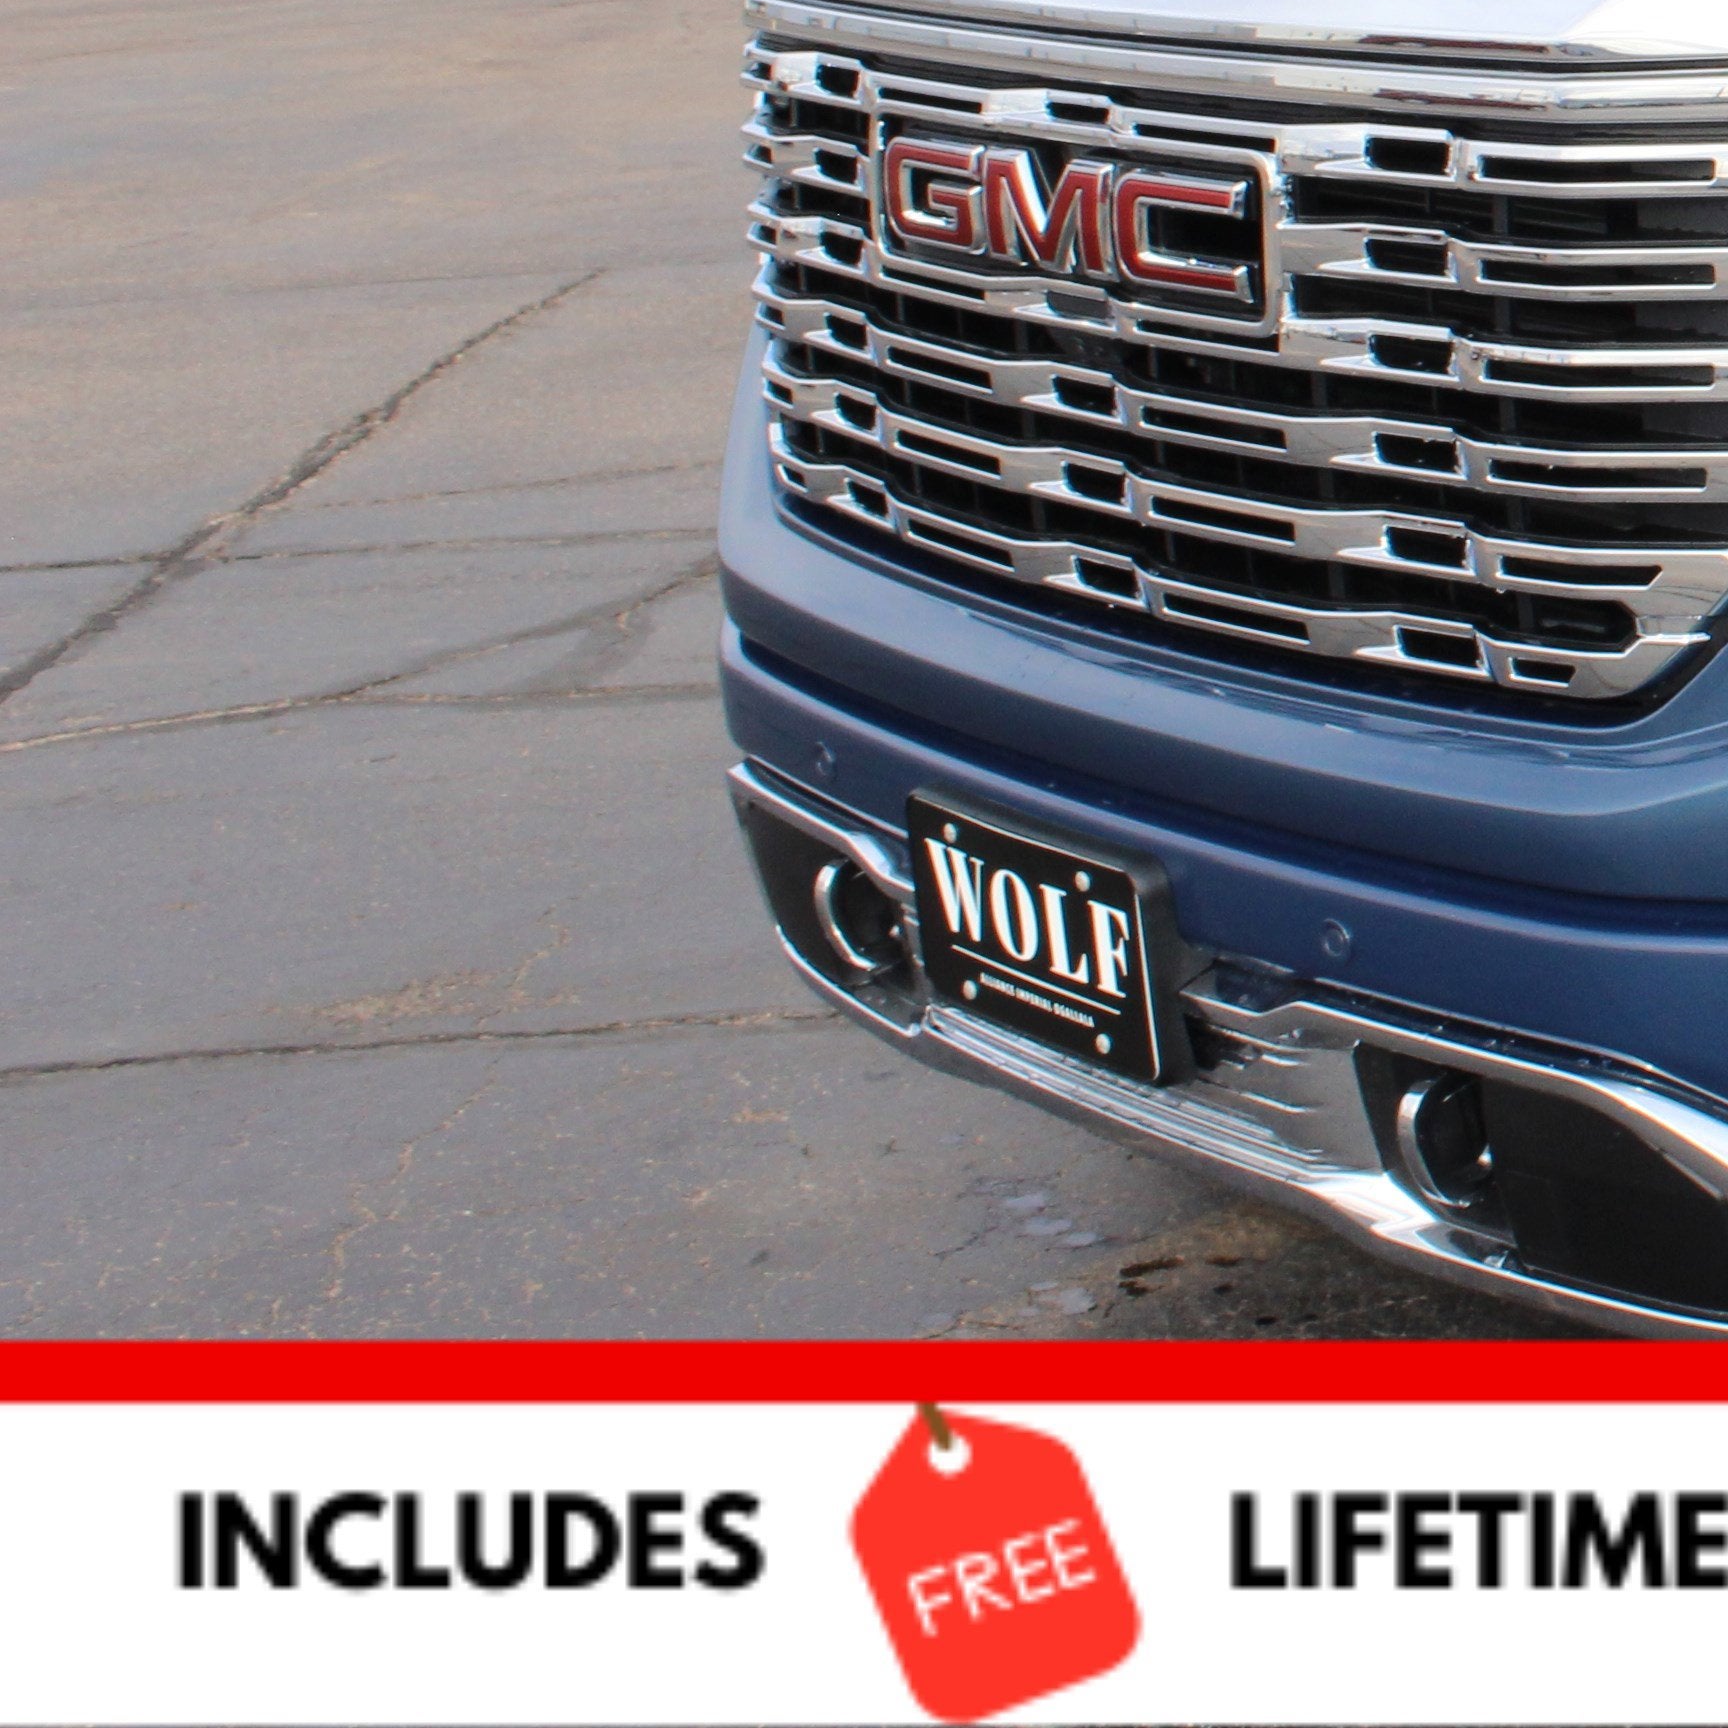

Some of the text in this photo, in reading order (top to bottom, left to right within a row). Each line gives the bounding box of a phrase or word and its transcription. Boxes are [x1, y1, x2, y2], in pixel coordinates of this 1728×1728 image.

[884, 135, 1255, 304] GMC
[923, 836, 1131, 999] WOLF
[1014, 986, 1053, 1013] IMPERIAL
